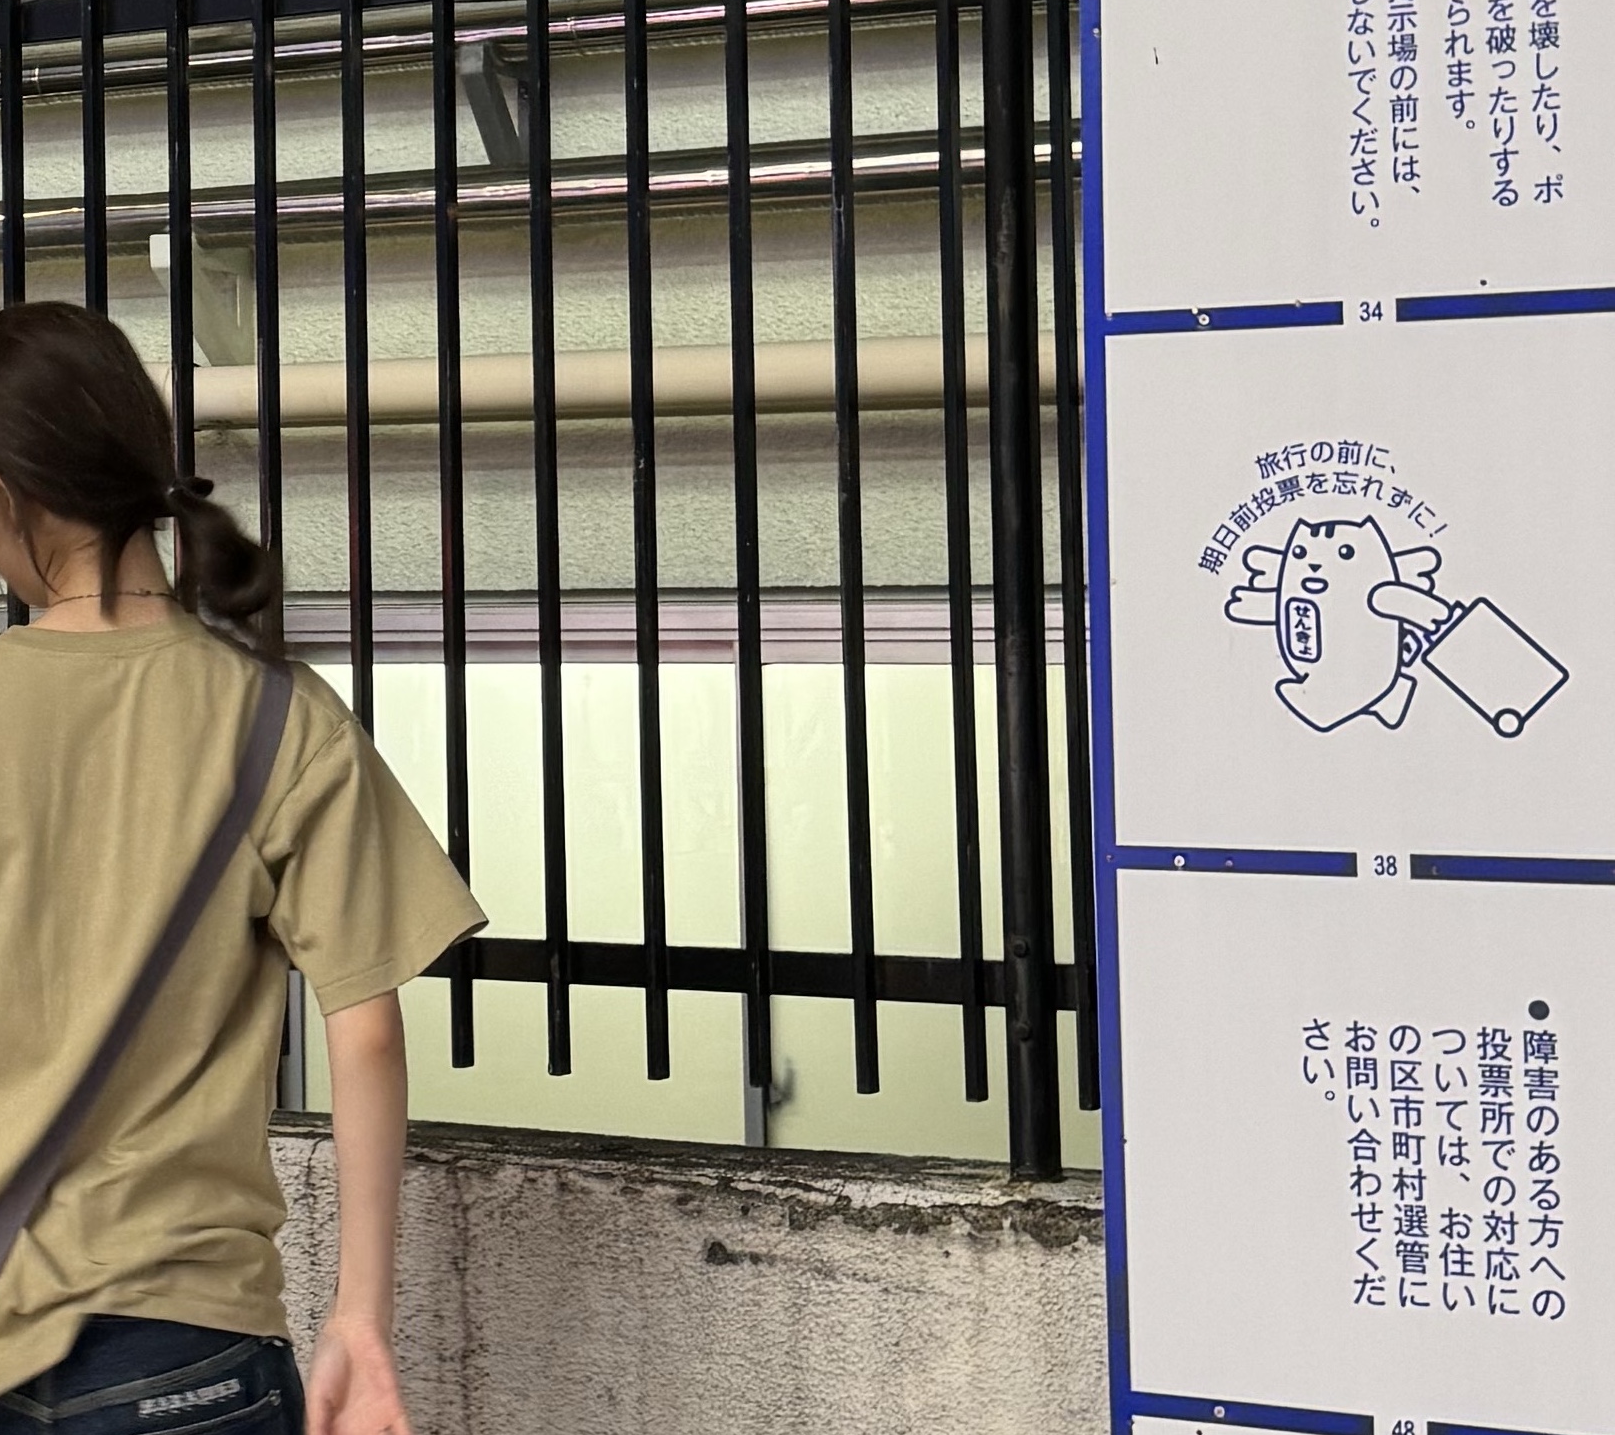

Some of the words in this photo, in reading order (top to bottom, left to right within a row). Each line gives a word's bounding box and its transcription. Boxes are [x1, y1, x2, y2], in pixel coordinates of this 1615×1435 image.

[1359, 300, 1384, 323] 34
[1294, 605, 1314, 656] せんきょ
[1373, 854, 1398, 877] 38
[1302, 1017, 1336, 1102] さい。
[1344, 1020, 1387, 1306] お問い合わせくだ
[1389, 1024, 1431, 1308] の区市町村選管に
[1476, 1026, 1521, 1316] 投票所での対応に
